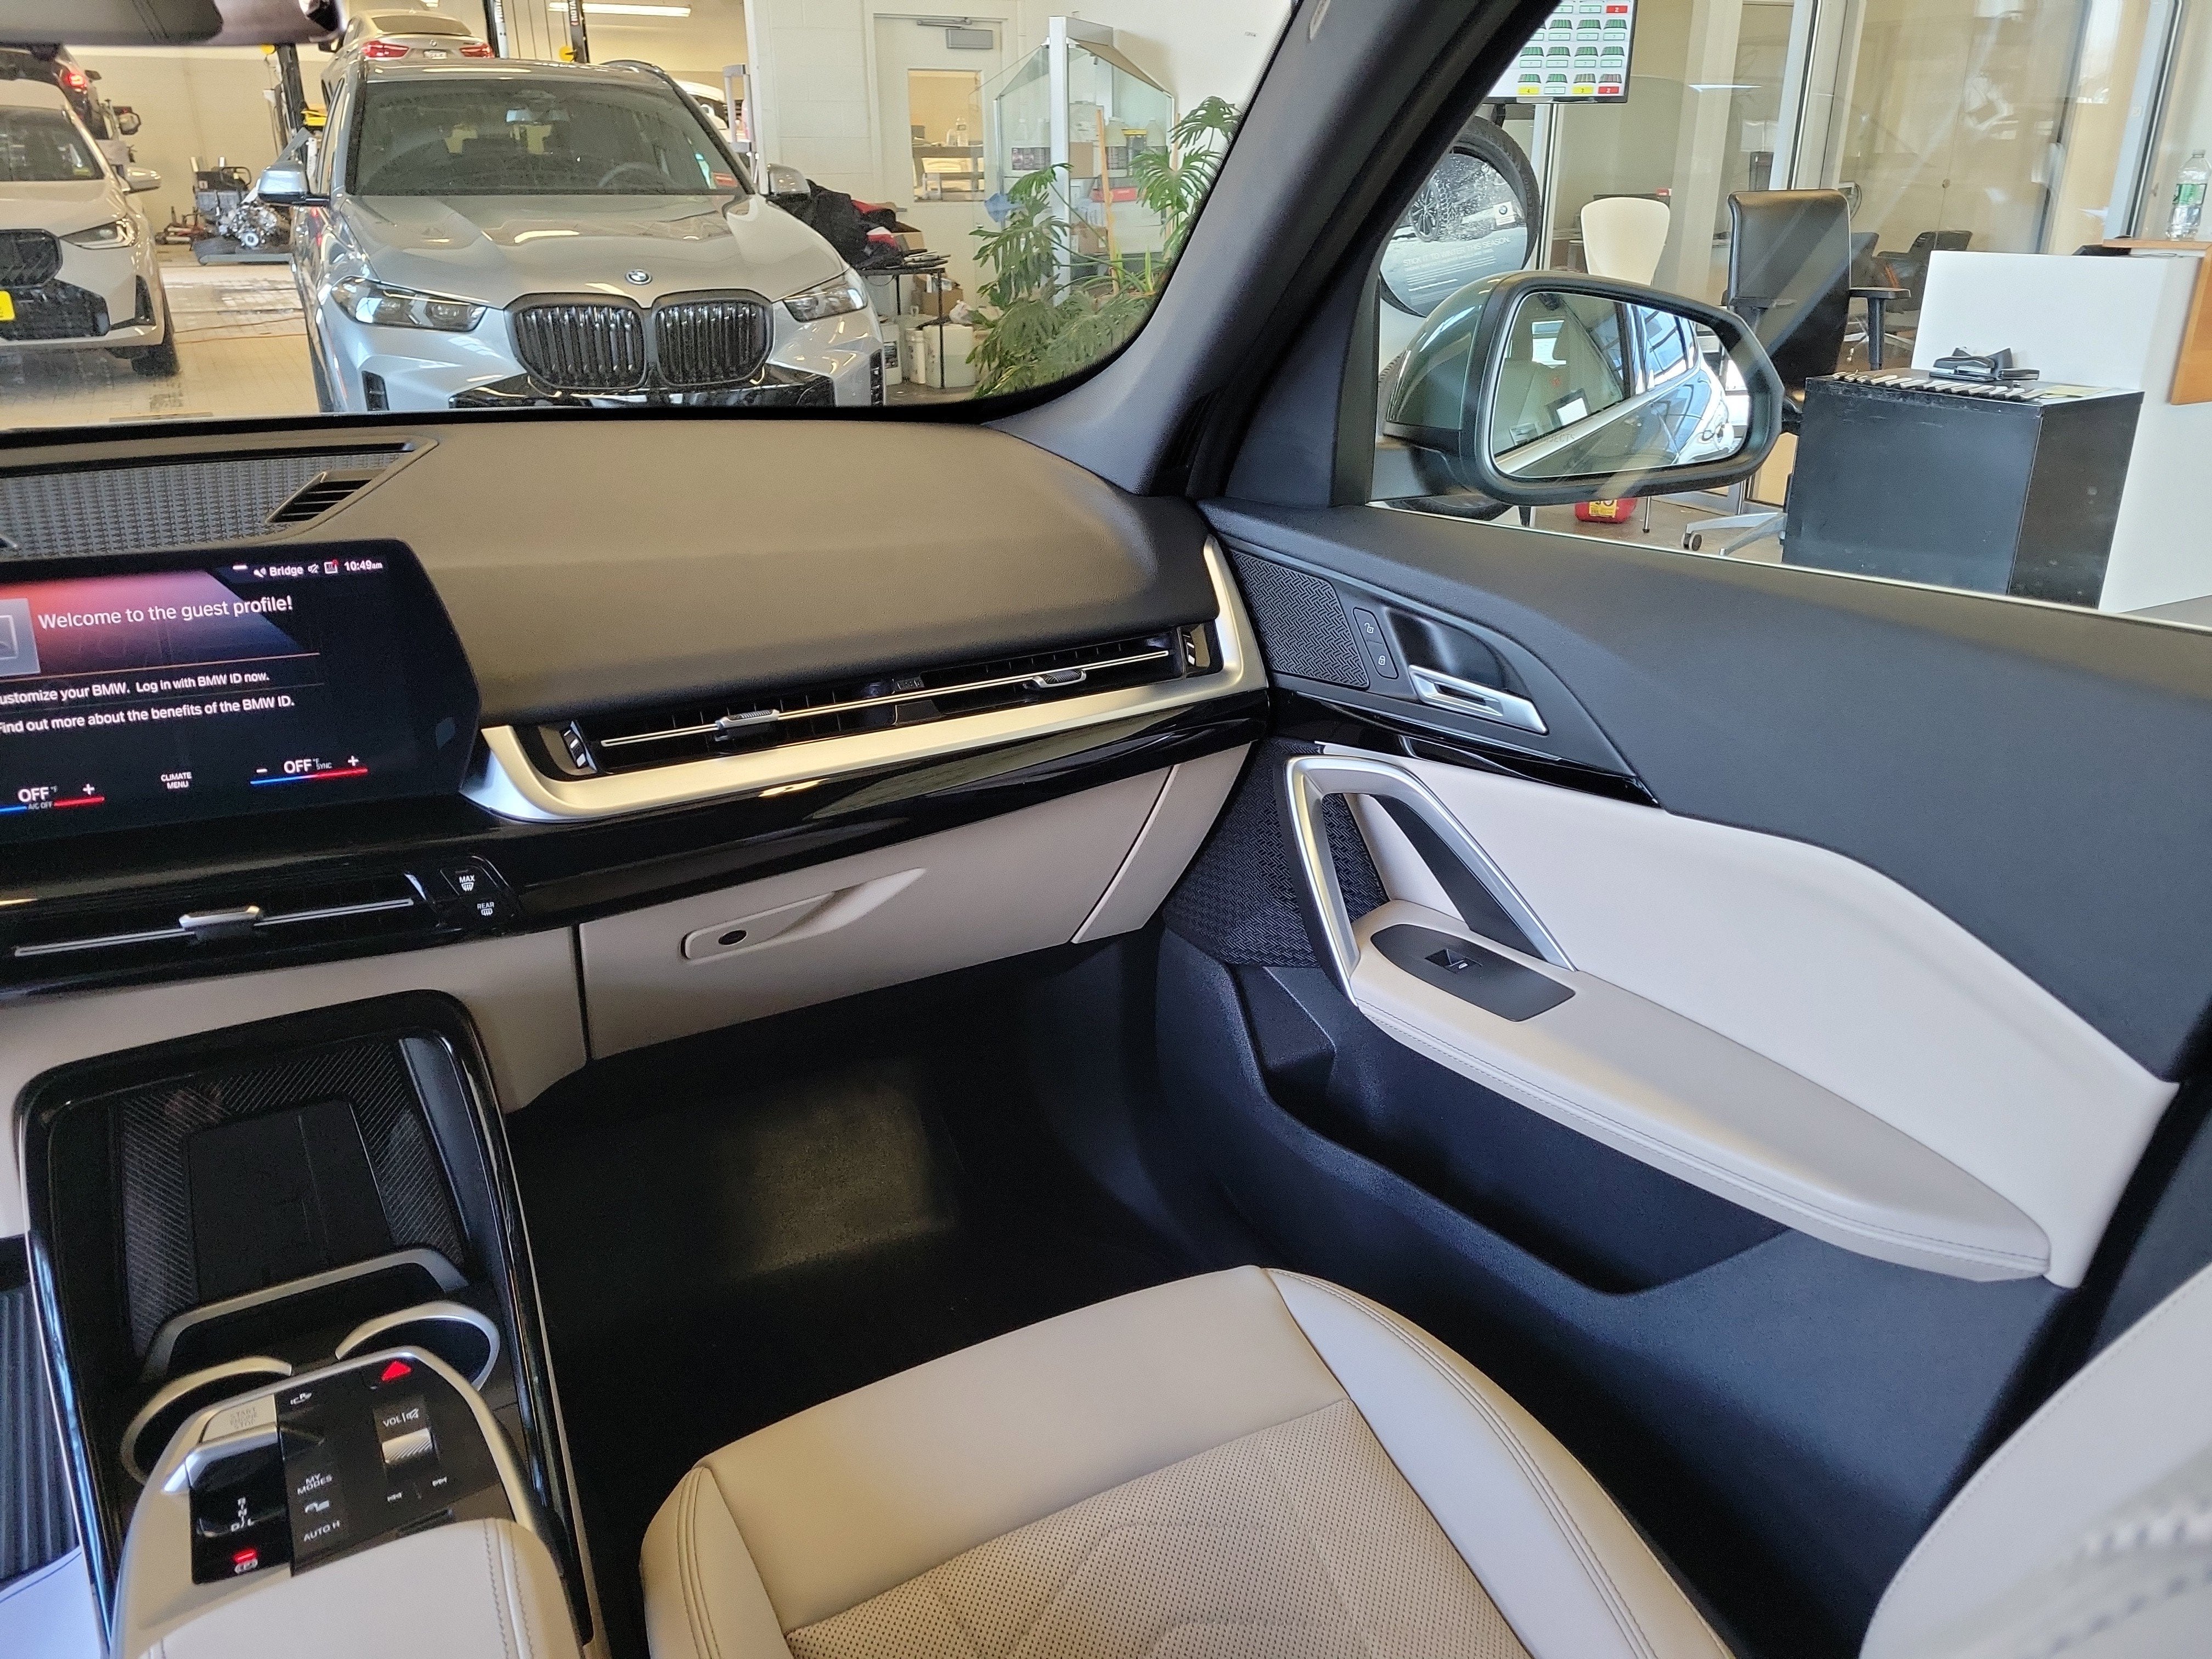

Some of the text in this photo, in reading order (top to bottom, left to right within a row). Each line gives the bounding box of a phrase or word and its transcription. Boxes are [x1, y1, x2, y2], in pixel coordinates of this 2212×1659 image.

[569, 0, 578, 21] ROTA
[269, 565, 304, 577] Bridge
[344, 560, 382, 572] 10:49am
[38, 595, 293, 629] Welcome to the guest profile!
[0, 672, 270, 705] ustomize your BMW. Log in with BMW ID now.
[26, 719, 49, 732] out
[51, 716, 86, 729] more
[88, 710, 125, 726] about
[127, 708, 149, 722] the
[151, 704, 202, 720] benefits
[204, 701, 218, 714] of
[219, 701, 241, 713] the
[242, 696, 275, 711] BMW
[278, 695, 295, 707] ID.
[283, 759, 312, 774] OFF
[161, 771, 192, 782] CLIMATE
[167, 780, 189, 790] MENU
[18, 786, 49, 803] OFF
[40, 800, 54, 809] OFF
[459, 874, 475, 884] MAX
[477, 901, 494, 910] REAR
[383, 1415, 402, 1427] VOL
[297, 1474, 333, 1496] MODES
[306, 1473, 321, 1485] MY
[303, 1520, 340, 1542] AUTO H
